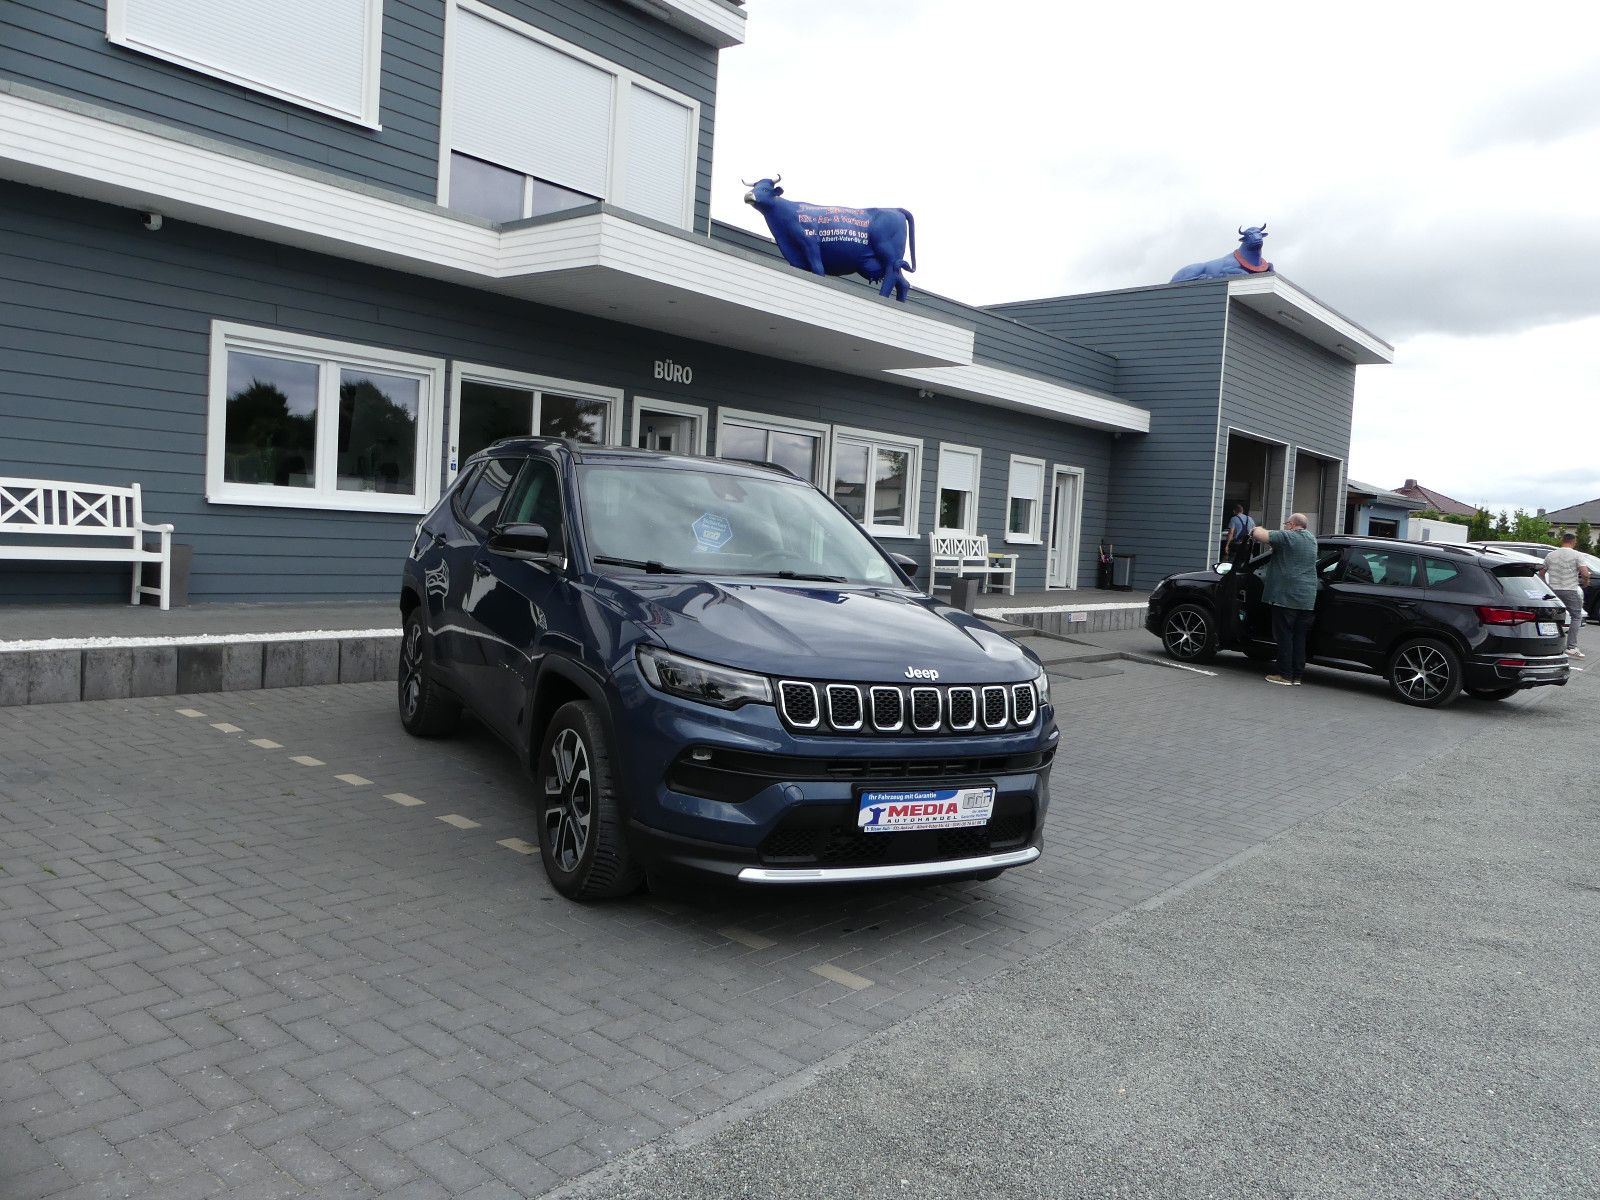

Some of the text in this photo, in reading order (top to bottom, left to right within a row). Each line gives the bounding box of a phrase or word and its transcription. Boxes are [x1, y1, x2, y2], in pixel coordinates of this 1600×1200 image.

[654, 358, 693, 385] BÜRO
[904, 666, 939, 681] Jeep
[868, 793, 877, 801] Ihr
[877, 793, 904, 801] Fahrzeug
[888, 802, 958, 817] MEDIA
